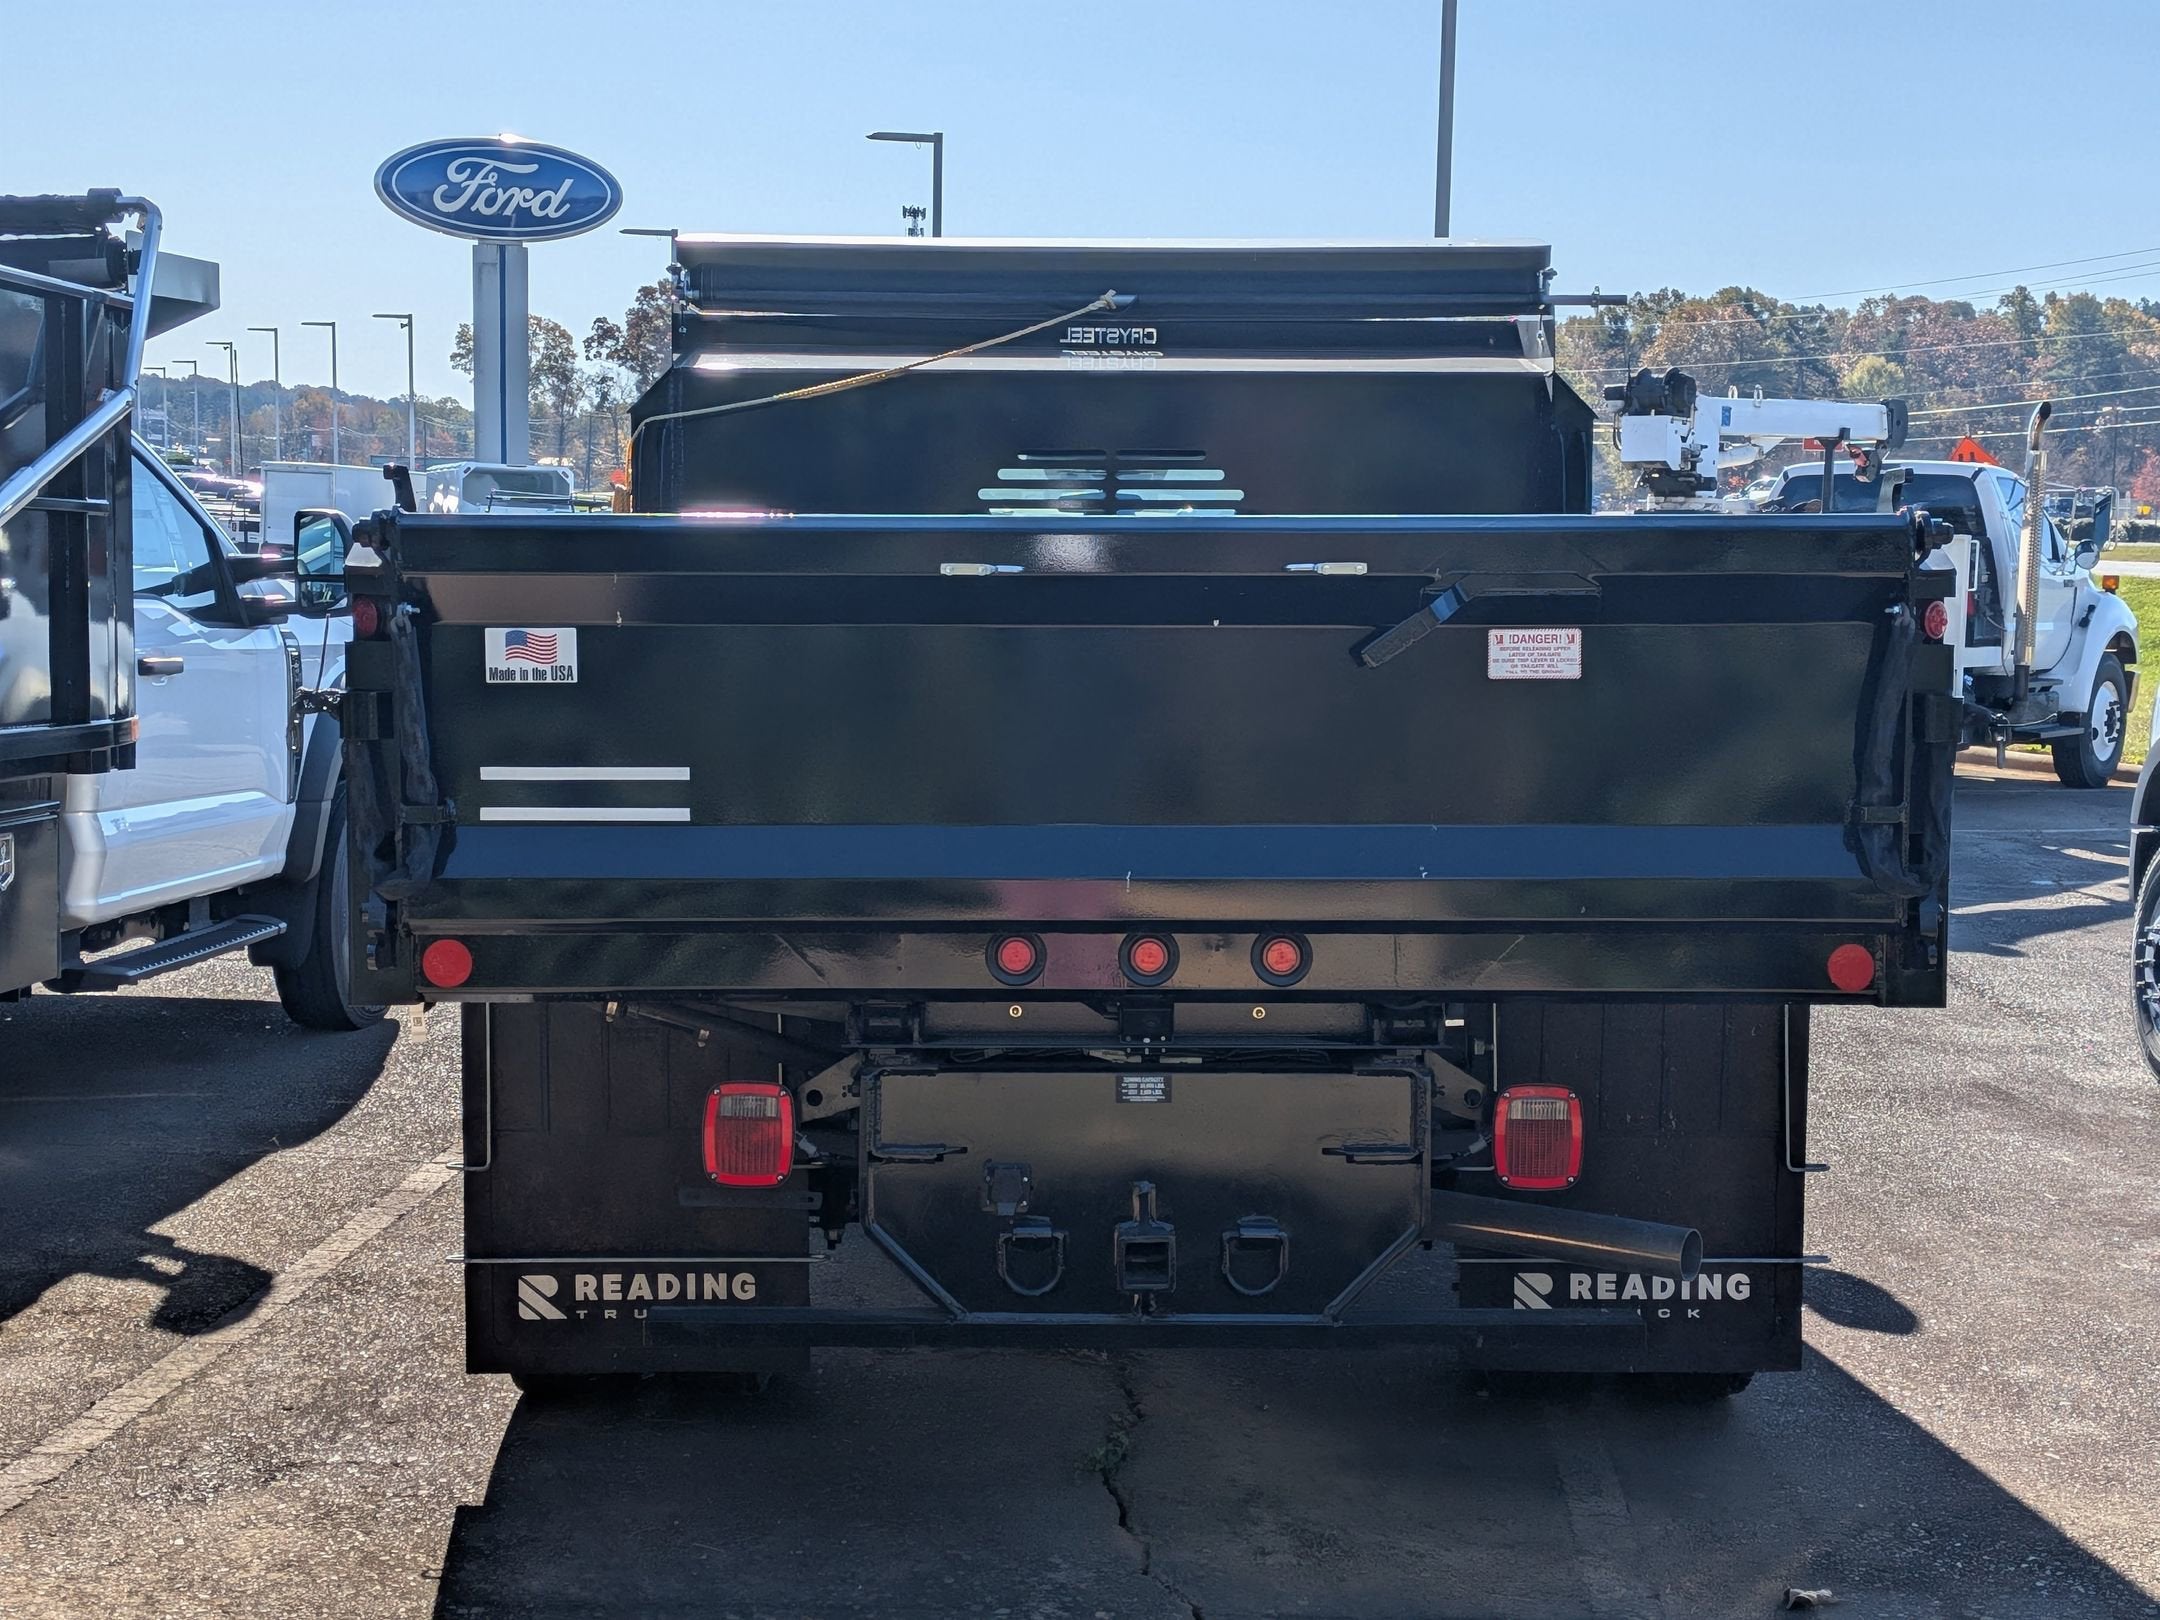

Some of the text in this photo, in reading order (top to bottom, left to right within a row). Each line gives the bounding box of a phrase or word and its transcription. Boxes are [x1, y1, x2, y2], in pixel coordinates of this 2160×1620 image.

[433, 157, 575, 218] Ford
[488, 665, 574, 681] Made in the USA
[575, 1272, 756, 1301] READING
[1569, 1273, 1751, 1300] READING
